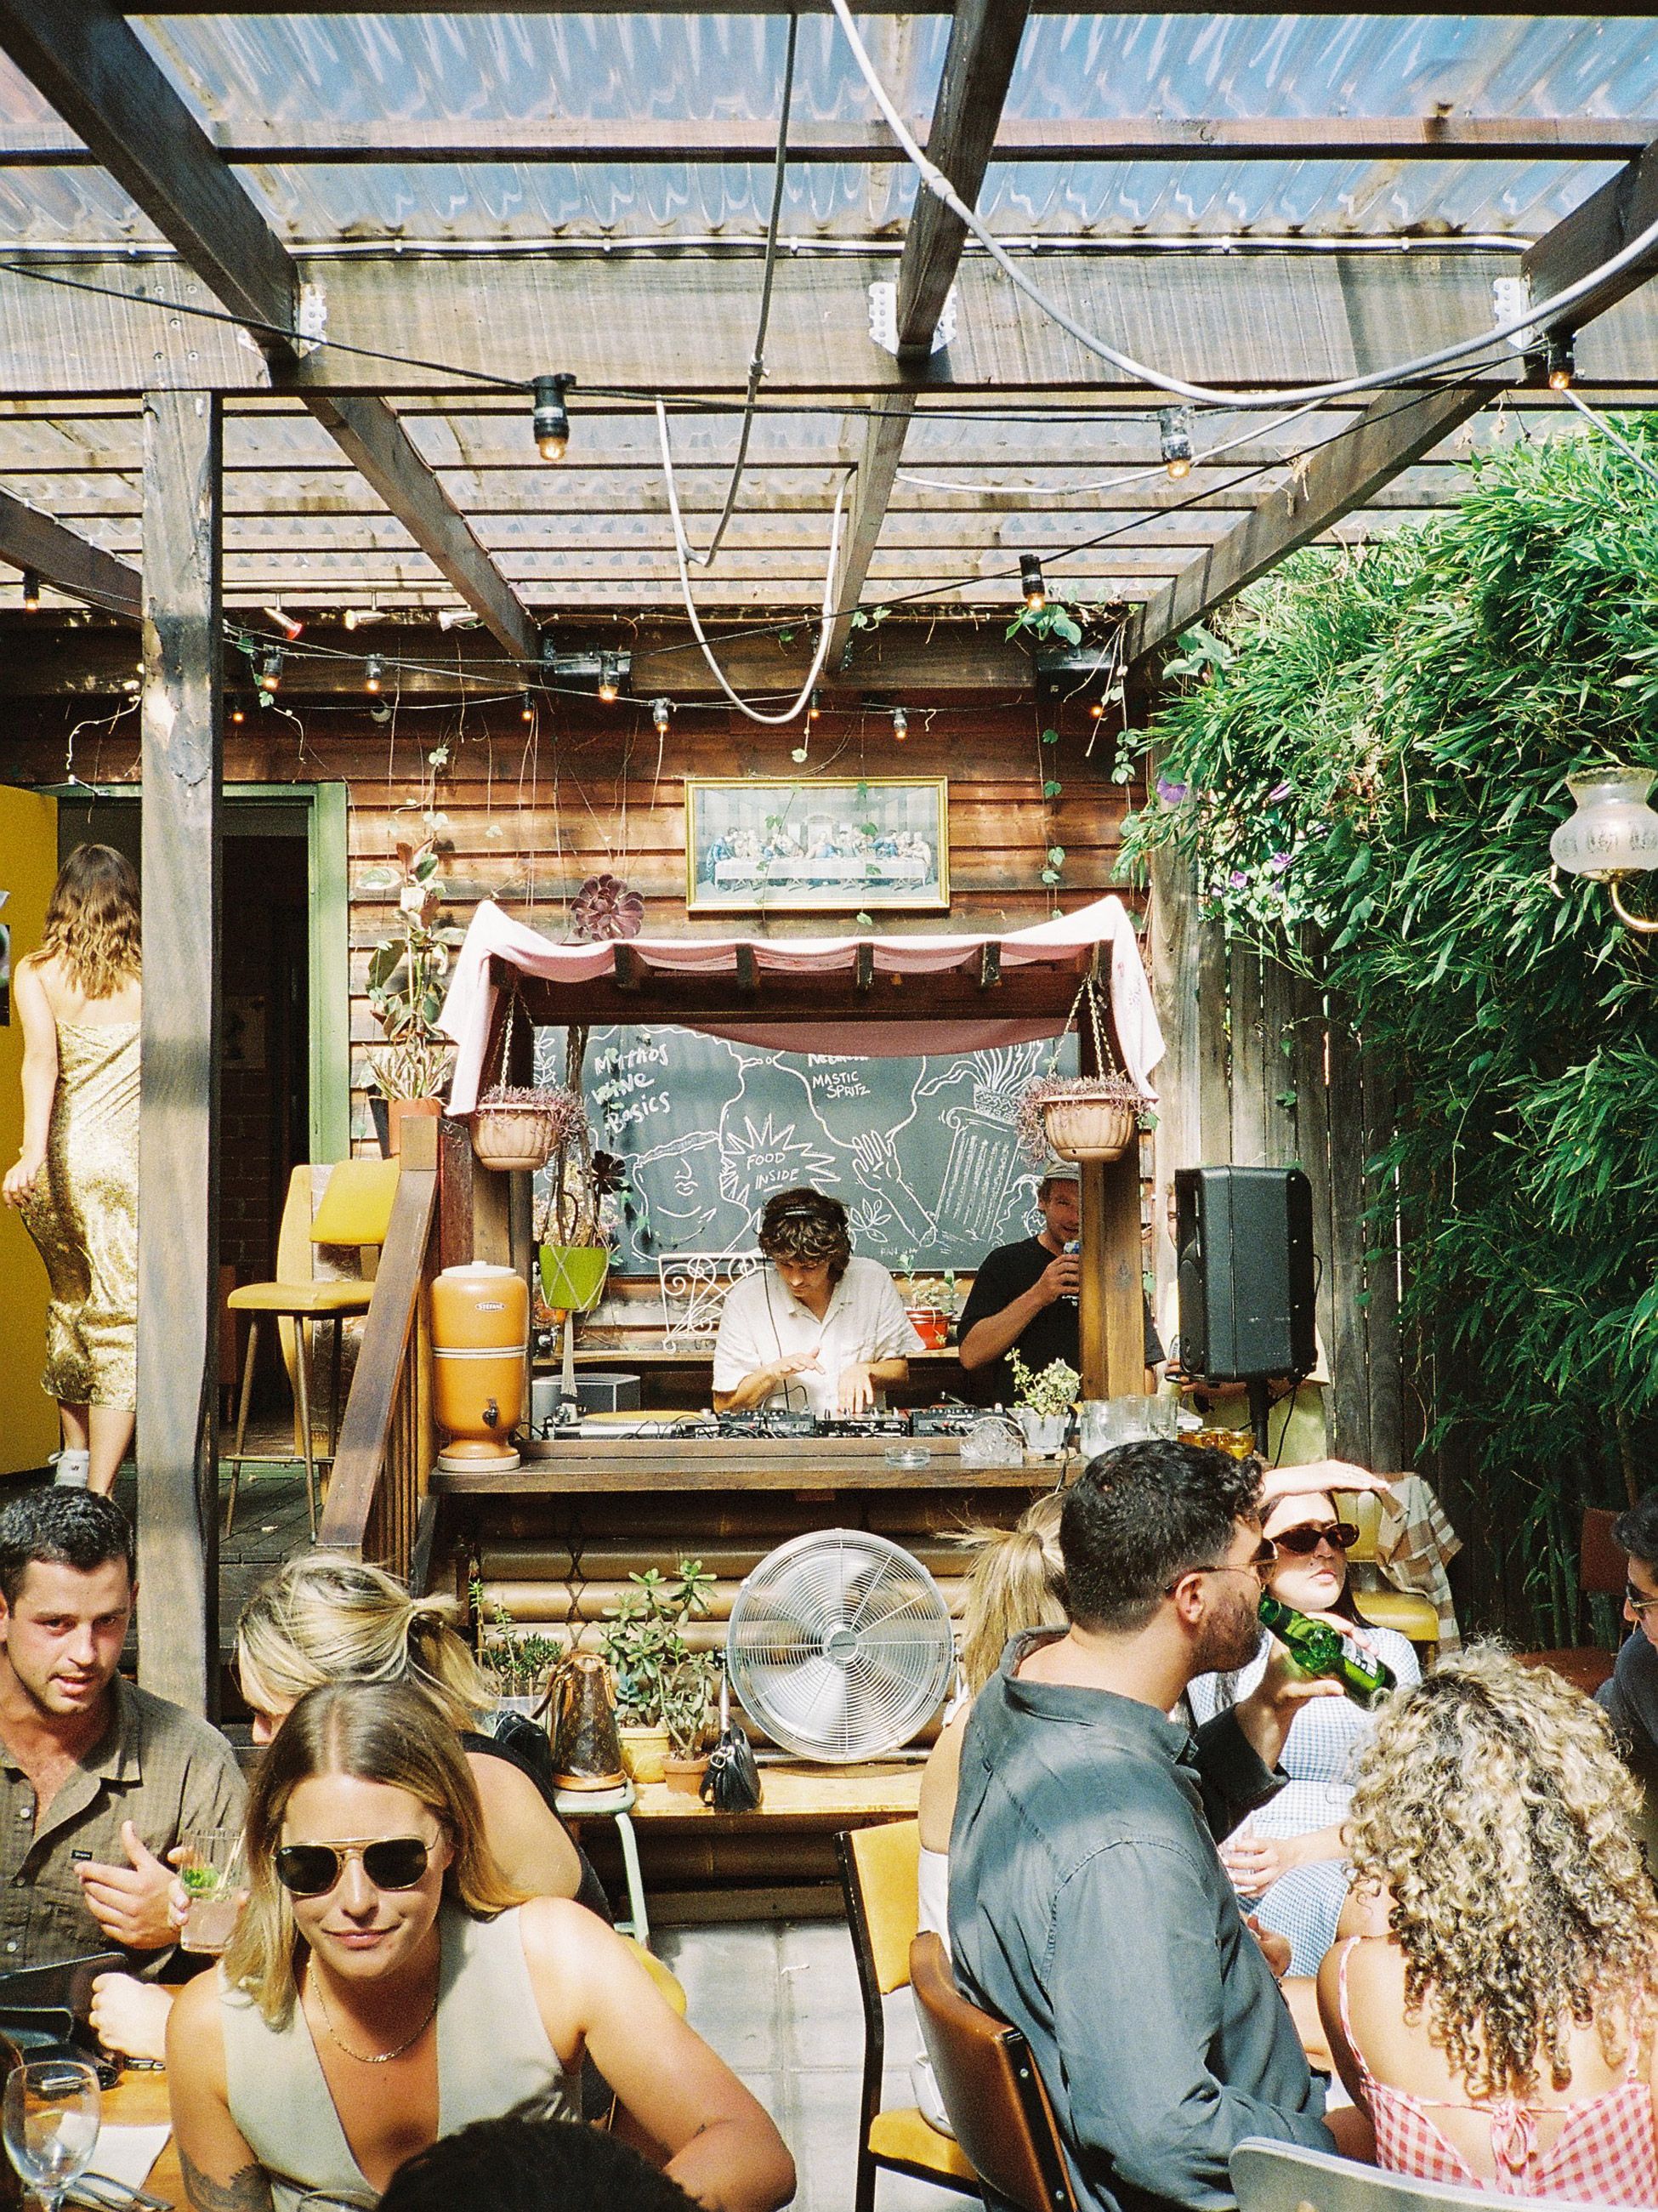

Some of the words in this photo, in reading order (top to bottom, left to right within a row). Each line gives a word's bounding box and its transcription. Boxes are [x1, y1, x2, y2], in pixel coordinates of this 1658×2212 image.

[812, 1071, 860, 1089] MASTIC
[826, 1083, 872, 1099] SPRITZ
[606, 1091, 671, 1134] Basics
[747, 1152, 786, 1171] FOOD
[755, 1168, 800, 1190] INSIDE
